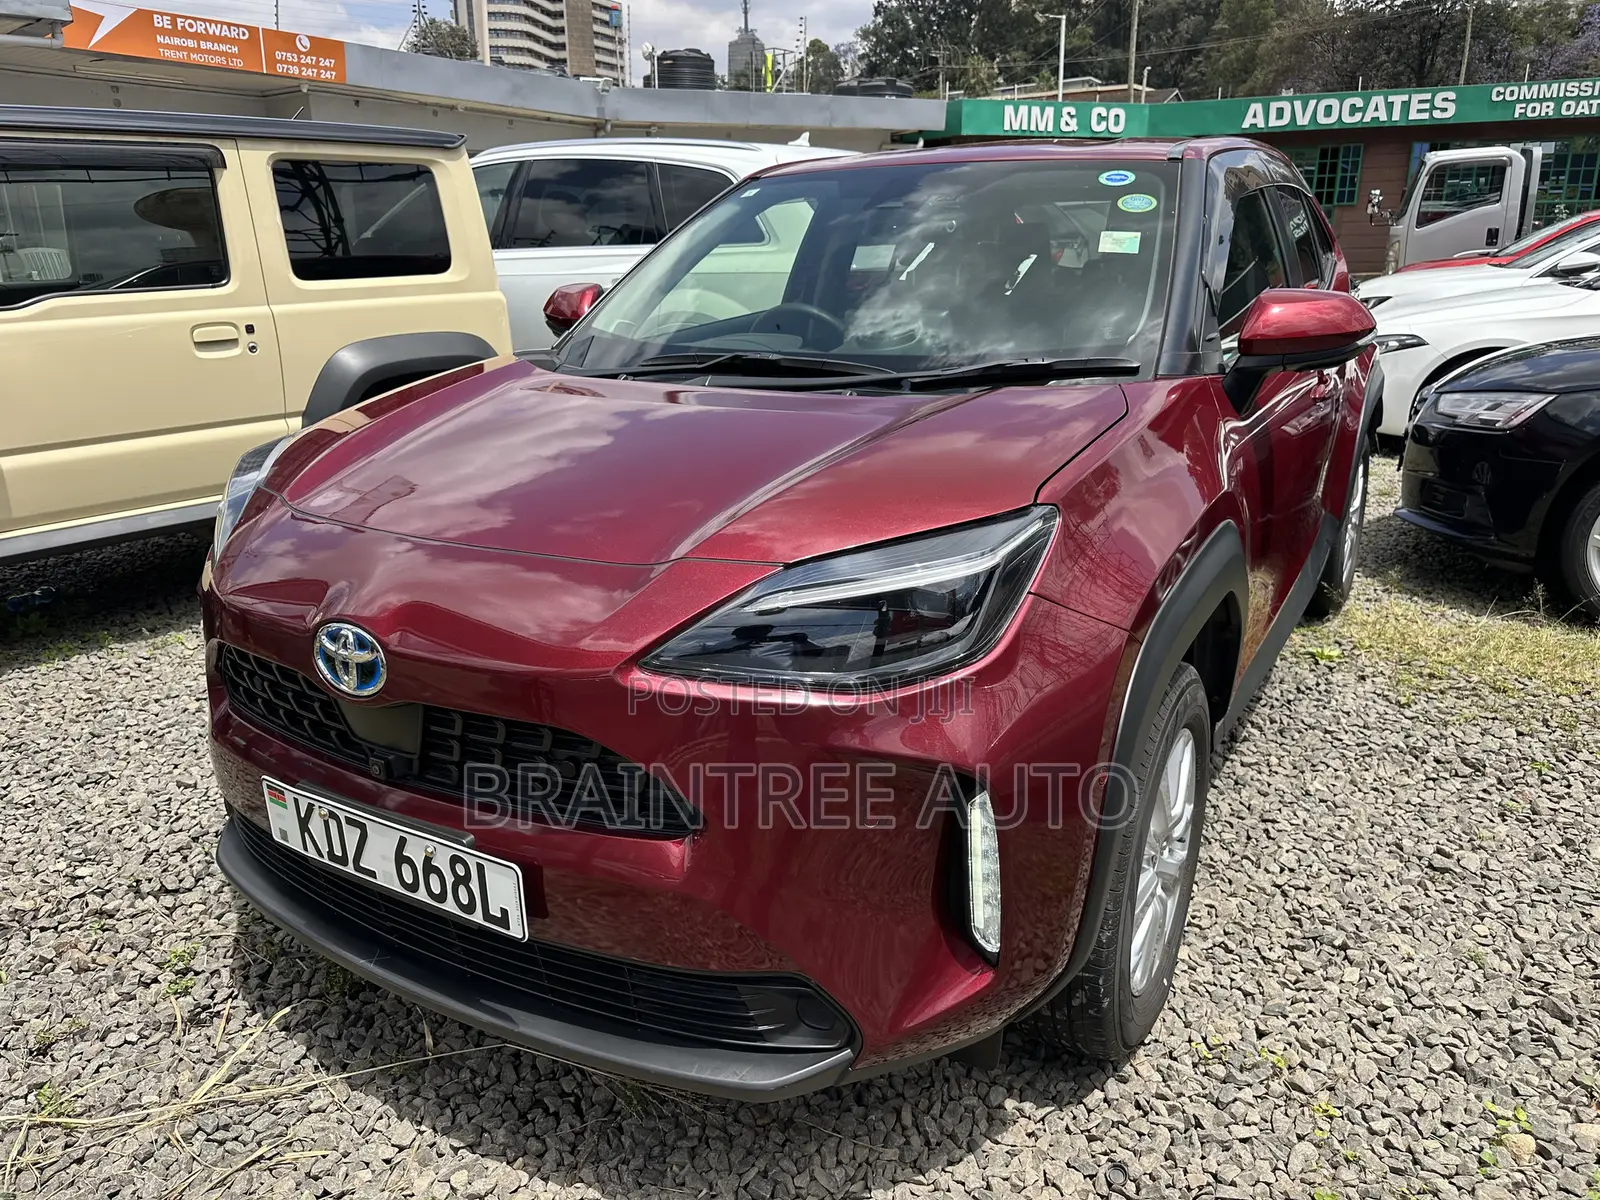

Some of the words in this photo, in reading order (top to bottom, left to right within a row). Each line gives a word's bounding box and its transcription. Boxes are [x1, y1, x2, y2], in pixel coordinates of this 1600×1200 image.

[153, 14, 172, 29] BE
[176, 17, 249, 40] FORWARD
[156, 34, 198, 49] NAIROBI
[200, 40, 239, 54] BRANCH
[158, 48, 188, 60] TRENT
[190, 52, 227, 65] MOTORS
[228, 58, 244, 67] LTD
[275, 50, 298, 62] 0753
[300, 55, 316, 65] 247
[319, 57, 335, 68] 247
[276, 63, 299, 75] 0739
[301, 67, 317, 77] 247
[320, 70, 336, 80] 247
[1491, 81, 1600, 102] COMMISSI
[1003, 104, 1055, 132] MM
[1060, 106, 1078, 132] &
[1090, 106, 1126, 133] CO
[1241, 91, 1457, 129] ADVOCATES
[1514, 101, 1555, 118] FOR
[1560, 99, 1600, 116] OAT
[293, 796, 378, 880] KDZ
[394, 835, 511, 931] 668L
